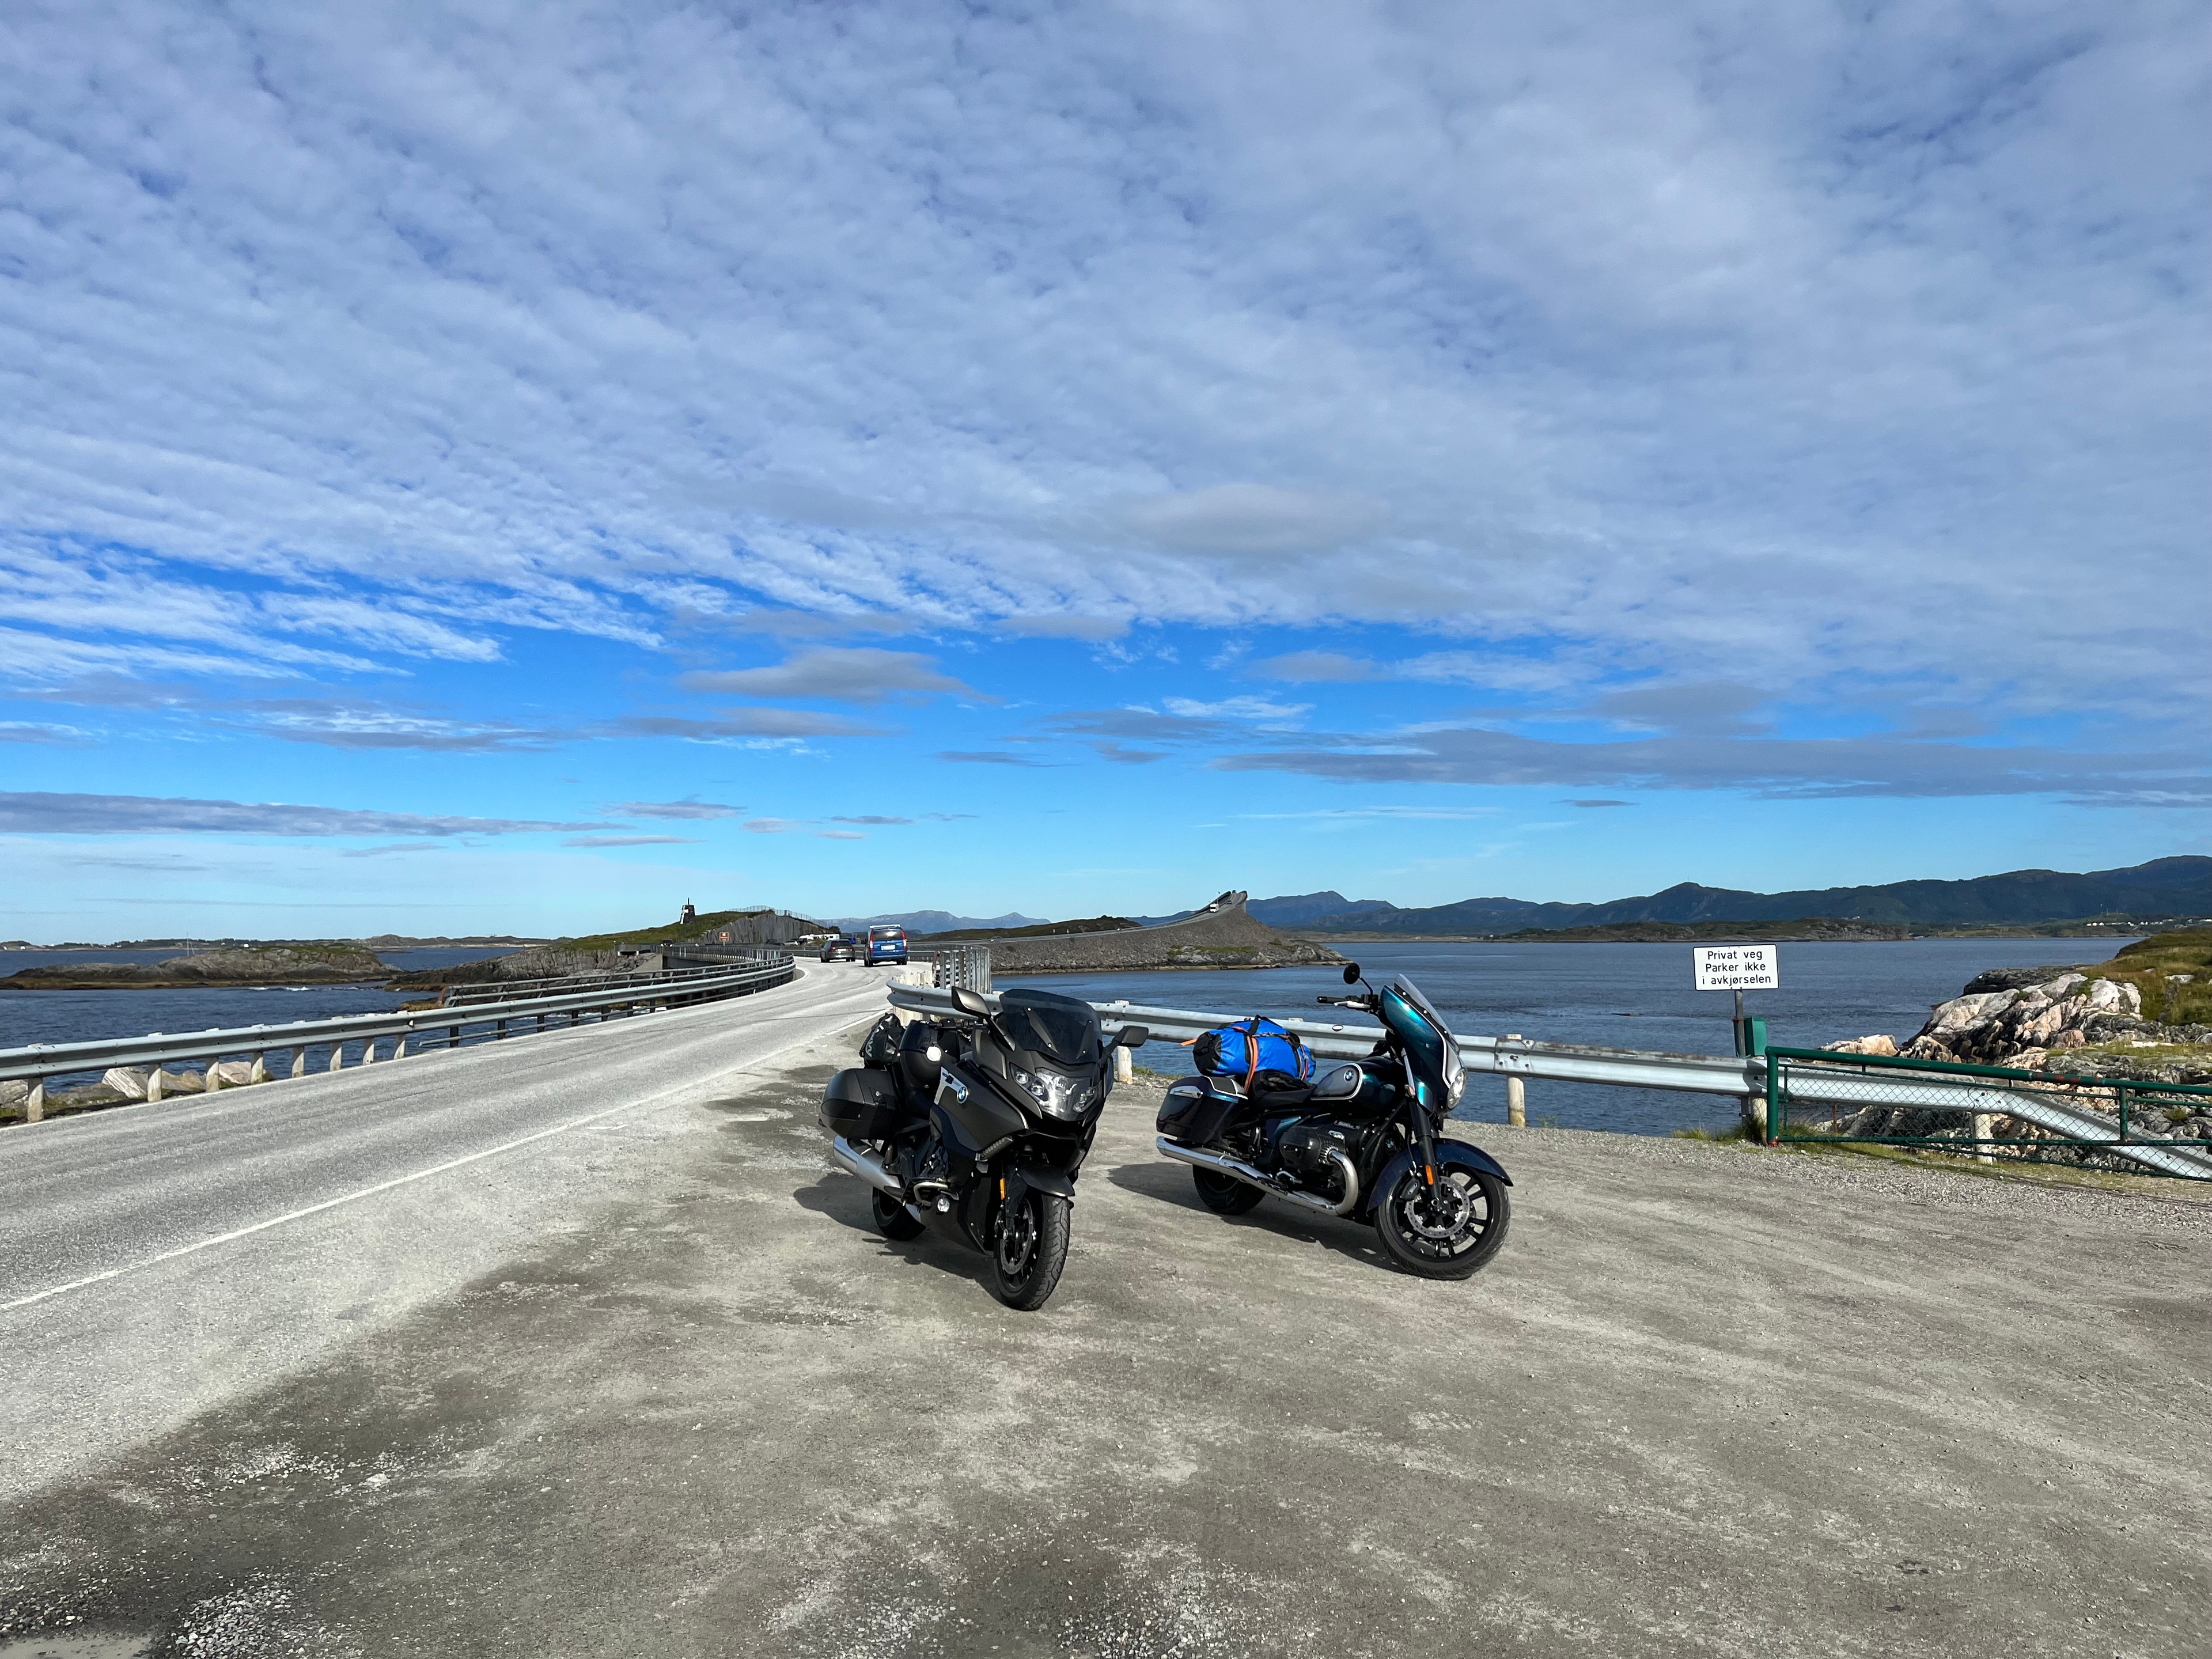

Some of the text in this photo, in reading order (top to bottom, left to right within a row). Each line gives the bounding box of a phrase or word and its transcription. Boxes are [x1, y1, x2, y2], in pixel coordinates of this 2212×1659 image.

[1707, 950, 1763, 960] Privat veg
[1706, 961, 1766, 972] Parker ikke
[1702, 974, 1771, 986] i avkjørselen
